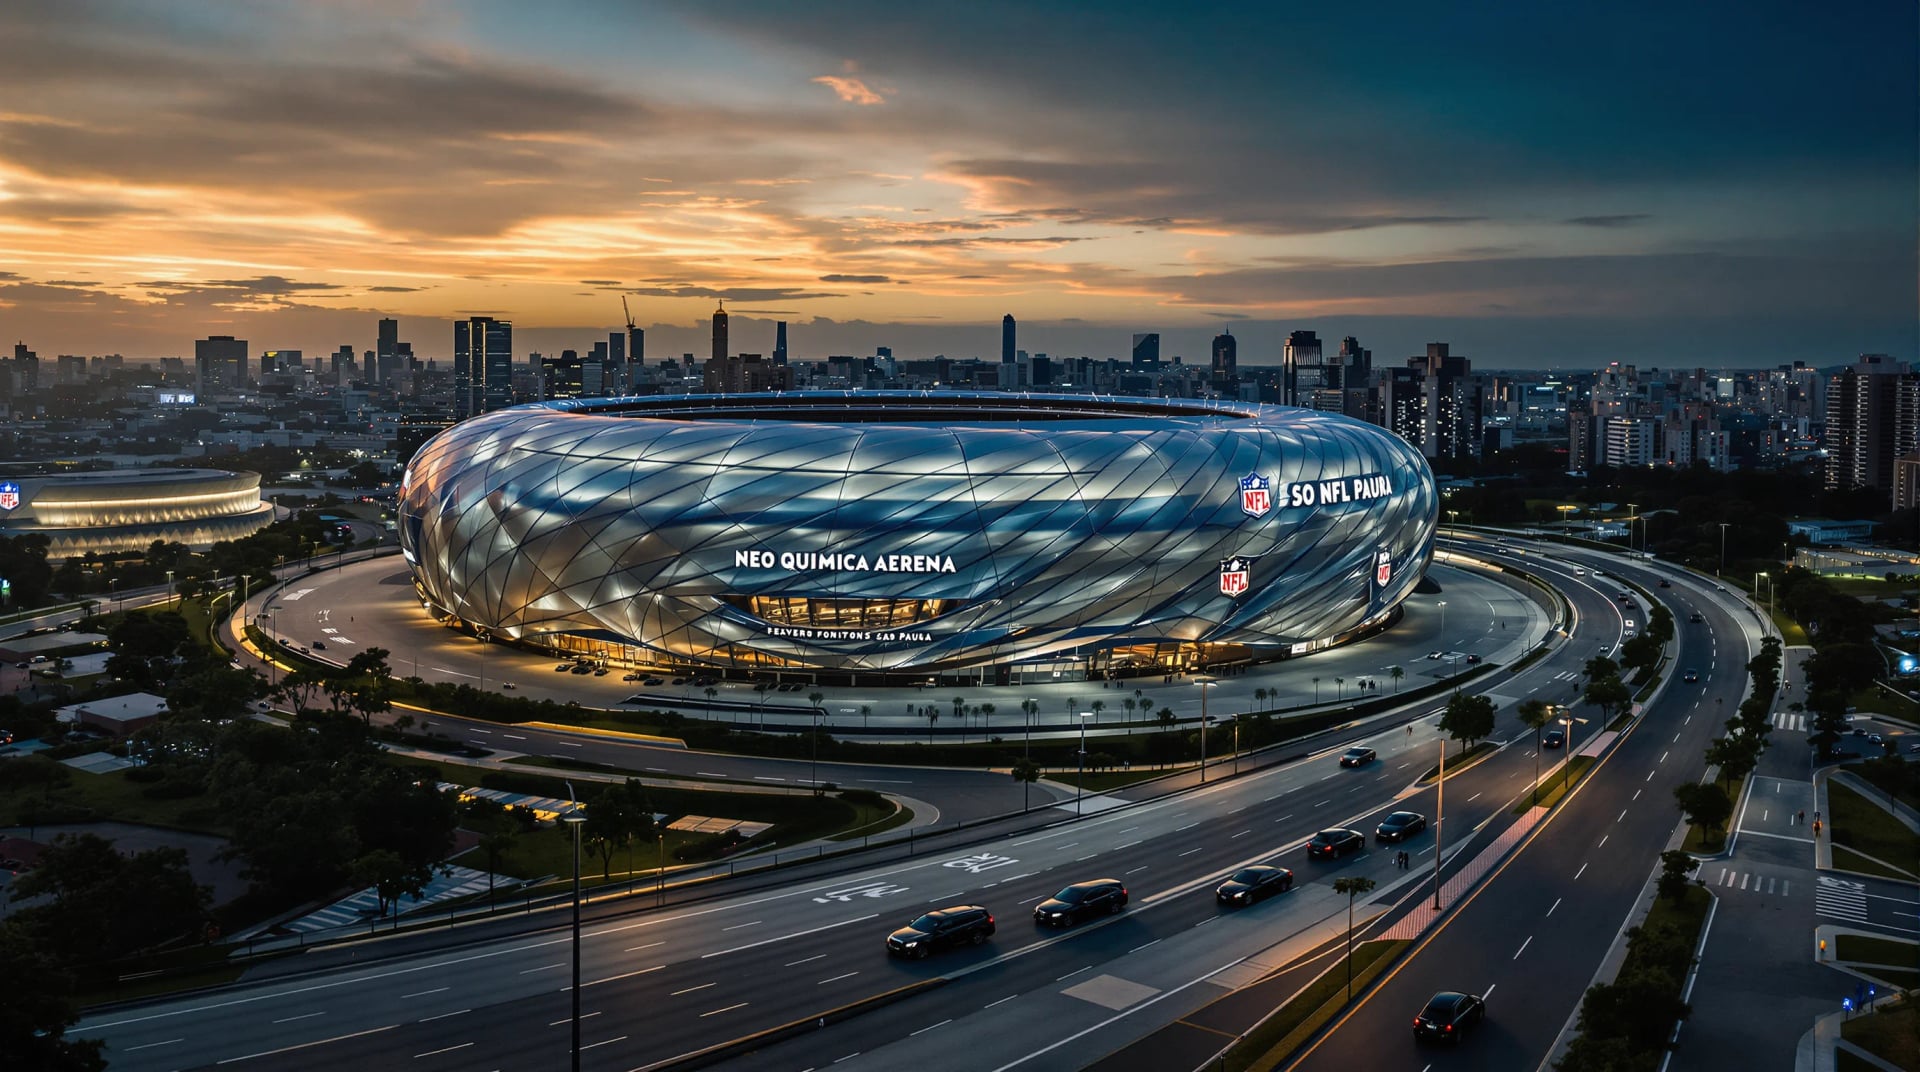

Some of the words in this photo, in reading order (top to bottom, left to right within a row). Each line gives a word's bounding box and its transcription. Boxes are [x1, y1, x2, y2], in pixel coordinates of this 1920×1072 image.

[1244, 491, 1270, 511] NFL
[1291, 484, 1315, 507] SO
[1319, 480, 1351, 505] NFL
[1354, 475, 1393, 500] PAURA
[735, 550, 775, 569] NEO
[780, 552, 870, 573] QUIMICA
[873, 554, 957, 574] AERENA
[1222, 573, 1247, 591] NFL
